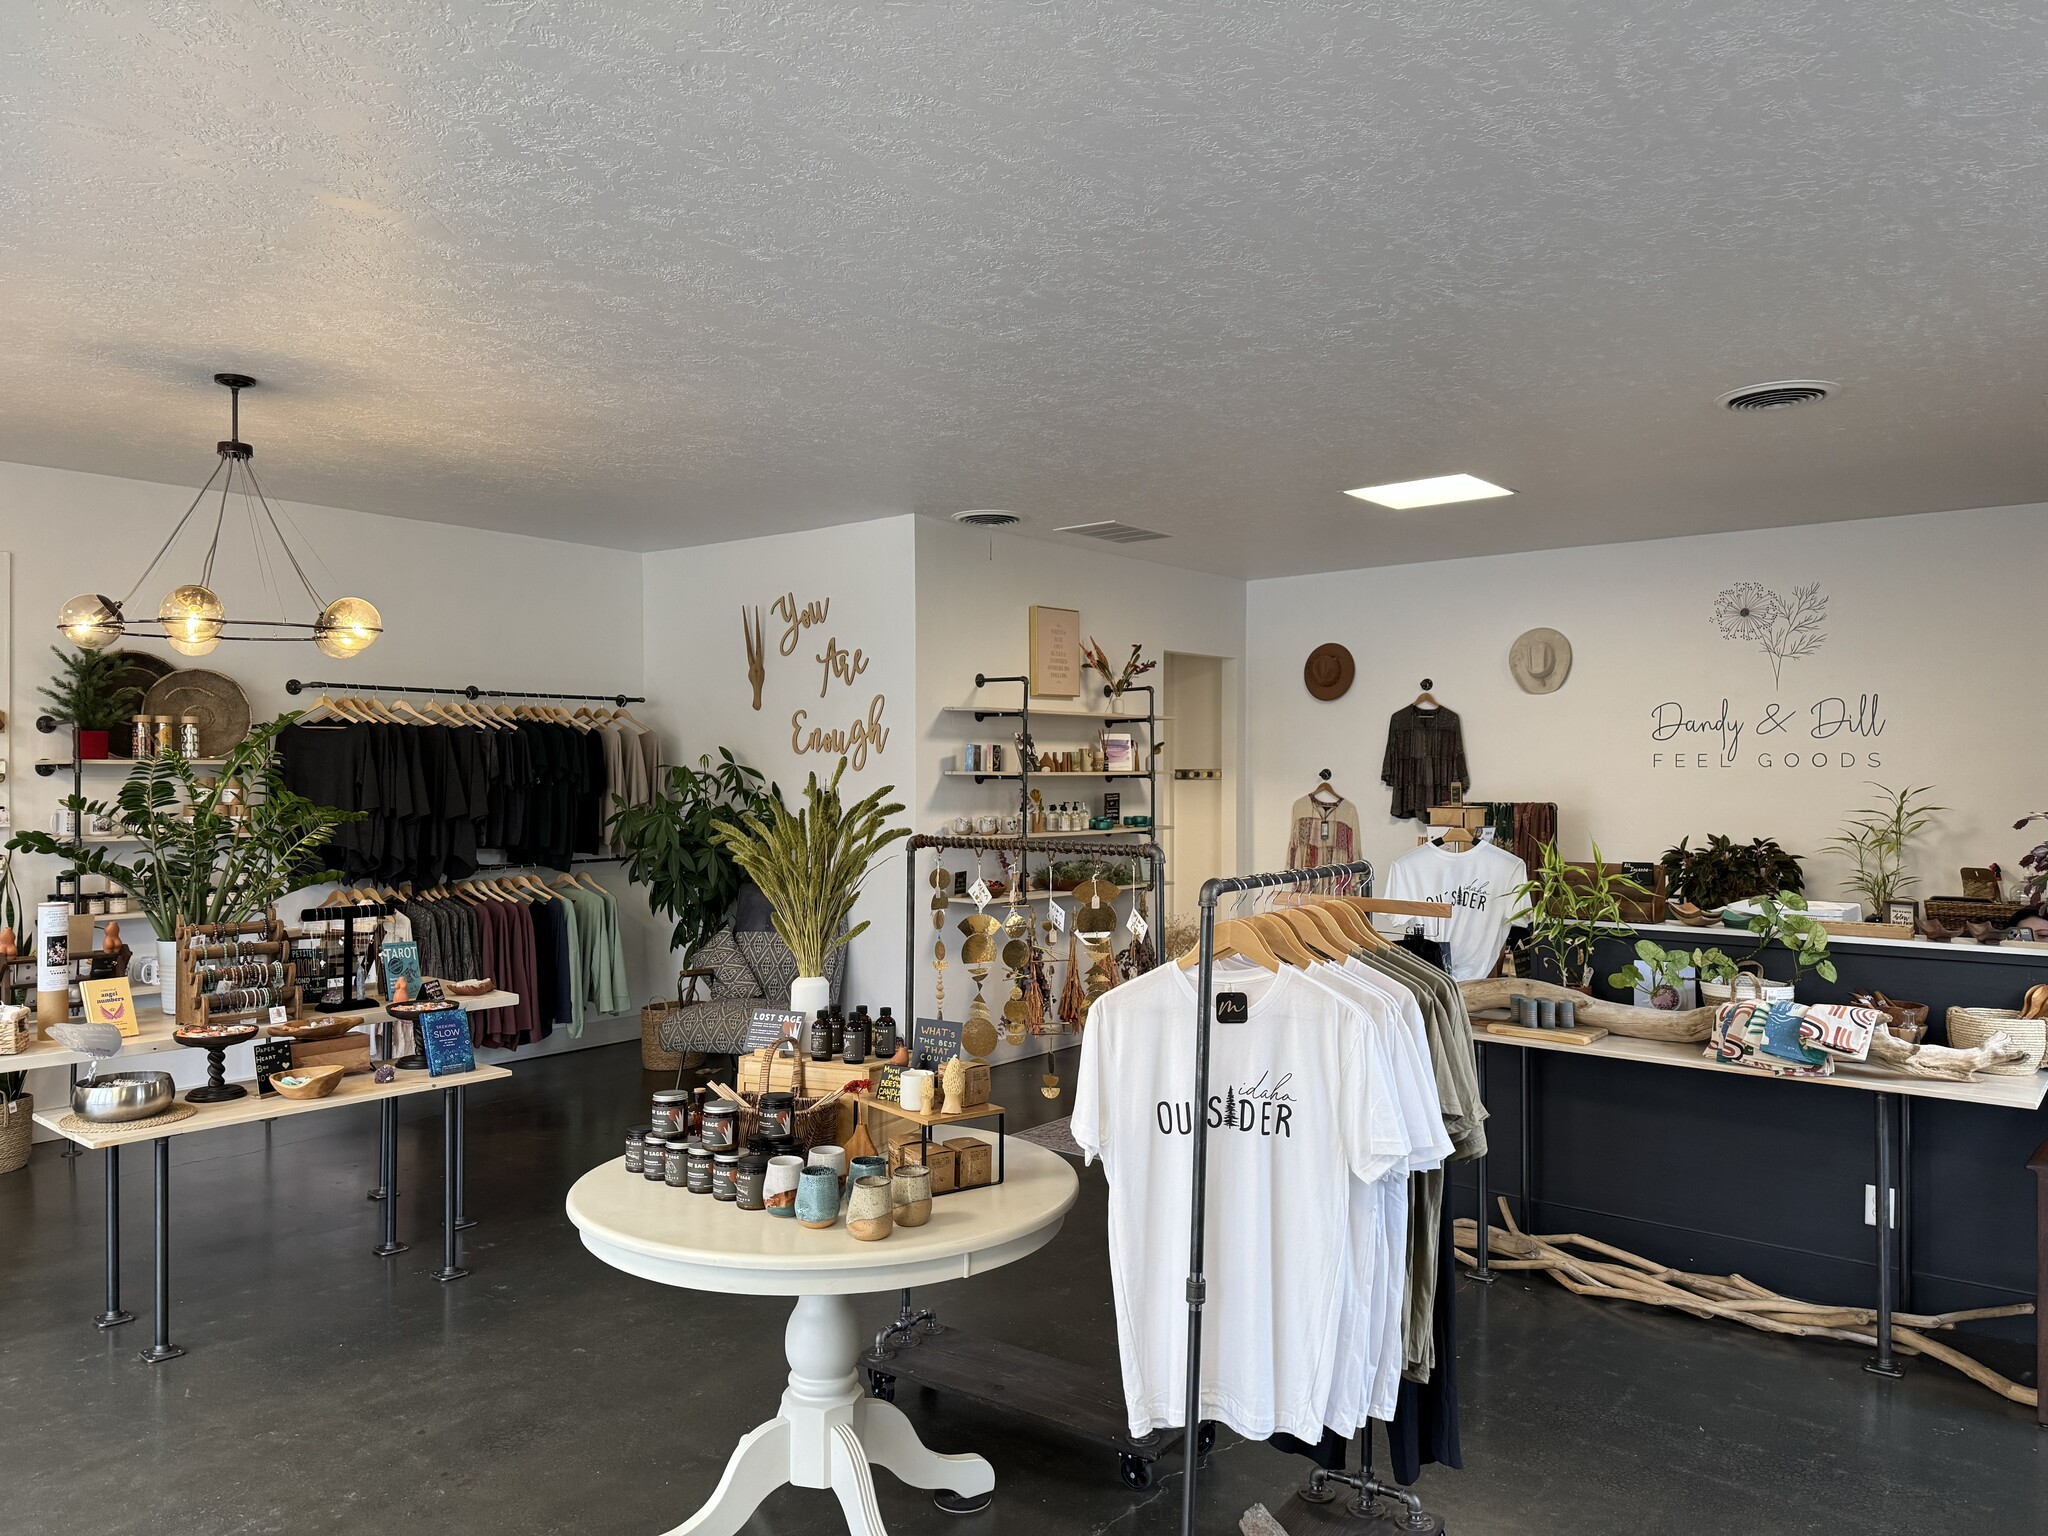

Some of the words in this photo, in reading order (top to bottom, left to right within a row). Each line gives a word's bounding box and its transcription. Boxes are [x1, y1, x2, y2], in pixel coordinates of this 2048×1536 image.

[770, 592, 829, 656] You
[816, 637, 869, 698] Are
[792, 694, 890, 771] Enough
[1651, 698, 1744, 762] Dandy
[1756, 703, 1796, 735] &
[1810, 694, 1886, 739] Dill
[1653, 753, 1731, 768] FEEL
[1758, 752, 1881, 768] GOODS
[1426, 887, 1487, 912] SIDER
[383, 946, 417, 963] TAROT
[101, 991, 118, 999] angel
[753, 1012, 776, 1021] LOST
[778, 1014, 802, 1023] SAGE
[434, 1029, 460, 1038] SLOW
[921, 1025, 956, 1038] WHAT'S
[919, 1037, 935, 1045] THE
[938, 1037, 957, 1048] BEST
[924, 1045, 950, 1055] THAT
[256, 1055, 276, 1063] HEART
[884, 1065, 900, 1074] Morel
[1238, 1070, 1297, 1102] idaho
[1157, 1090, 1292, 1138] OUSIDER
